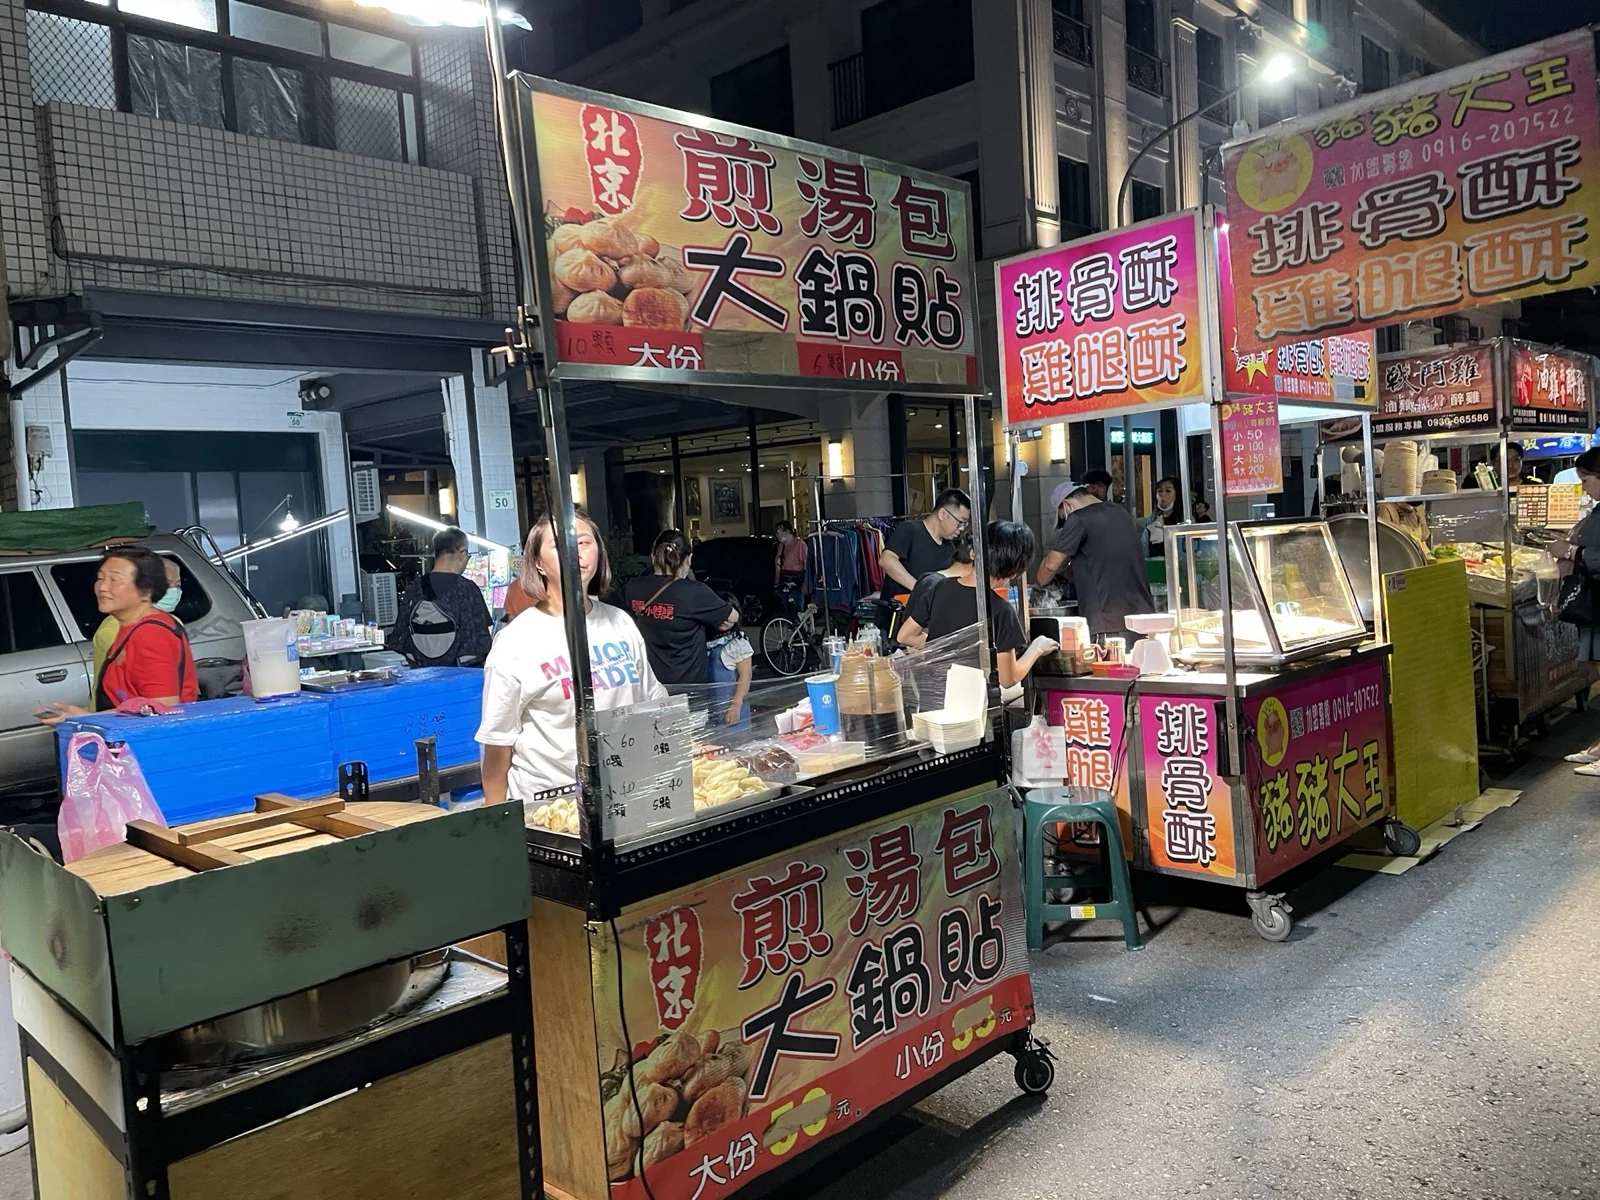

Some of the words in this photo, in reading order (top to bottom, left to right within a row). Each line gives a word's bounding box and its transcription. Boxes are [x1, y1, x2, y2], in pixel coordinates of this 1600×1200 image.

[590, 113, 631, 209] 北京
[1421, 105, 1575, 163] 0916-207522
[674, 131, 957, 260] 煎湯包
[1249, 134, 1582, 275] 排骨酥
[683, 232, 964, 350] 大鍋貼
[1014, 235, 1179, 336] 排骨酥
[1252, 213, 1588, 341] 雞腿酥
[628, 342, 702, 370] 大份
[849, 358, 900, 381] 小份
[1022, 313, 1187, 404] 雞腿酥
[1277, 340, 1325, 376] 排骨酥
[1233, 431, 1243, 441] 小
[1247, 429, 1262, 440] 50
[1233, 444, 1244, 452] 中
[1248, 441, 1264, 451] 100
[1233, 456, 1244, 465] 大
[1248, 454, 1264, 463] 150
[1248, 465, 1264, 475] 200
[495, 497, 508, 508] 50
[541, 640, 633, 681] MJOR
[620, 733, 635, 748] 60
[1332, 684, 1379, 722] 0916-207522
[1155, 701, 1217, 864] 排骨酥
[1261, 729, 1384, 850] 豬豬大王
[732, 804, 999, 990] 煎湯包
[654, 911, 694, 1020] 北京
[740, 892, 1006, 1101] 大鍋貼
[896, 1031, 945, 1079] 小份
[999, 1008, 1012, 1025] 元
[689, 1132, 759, 1200] 大份
[837, 1098, 851, 1120] 元
